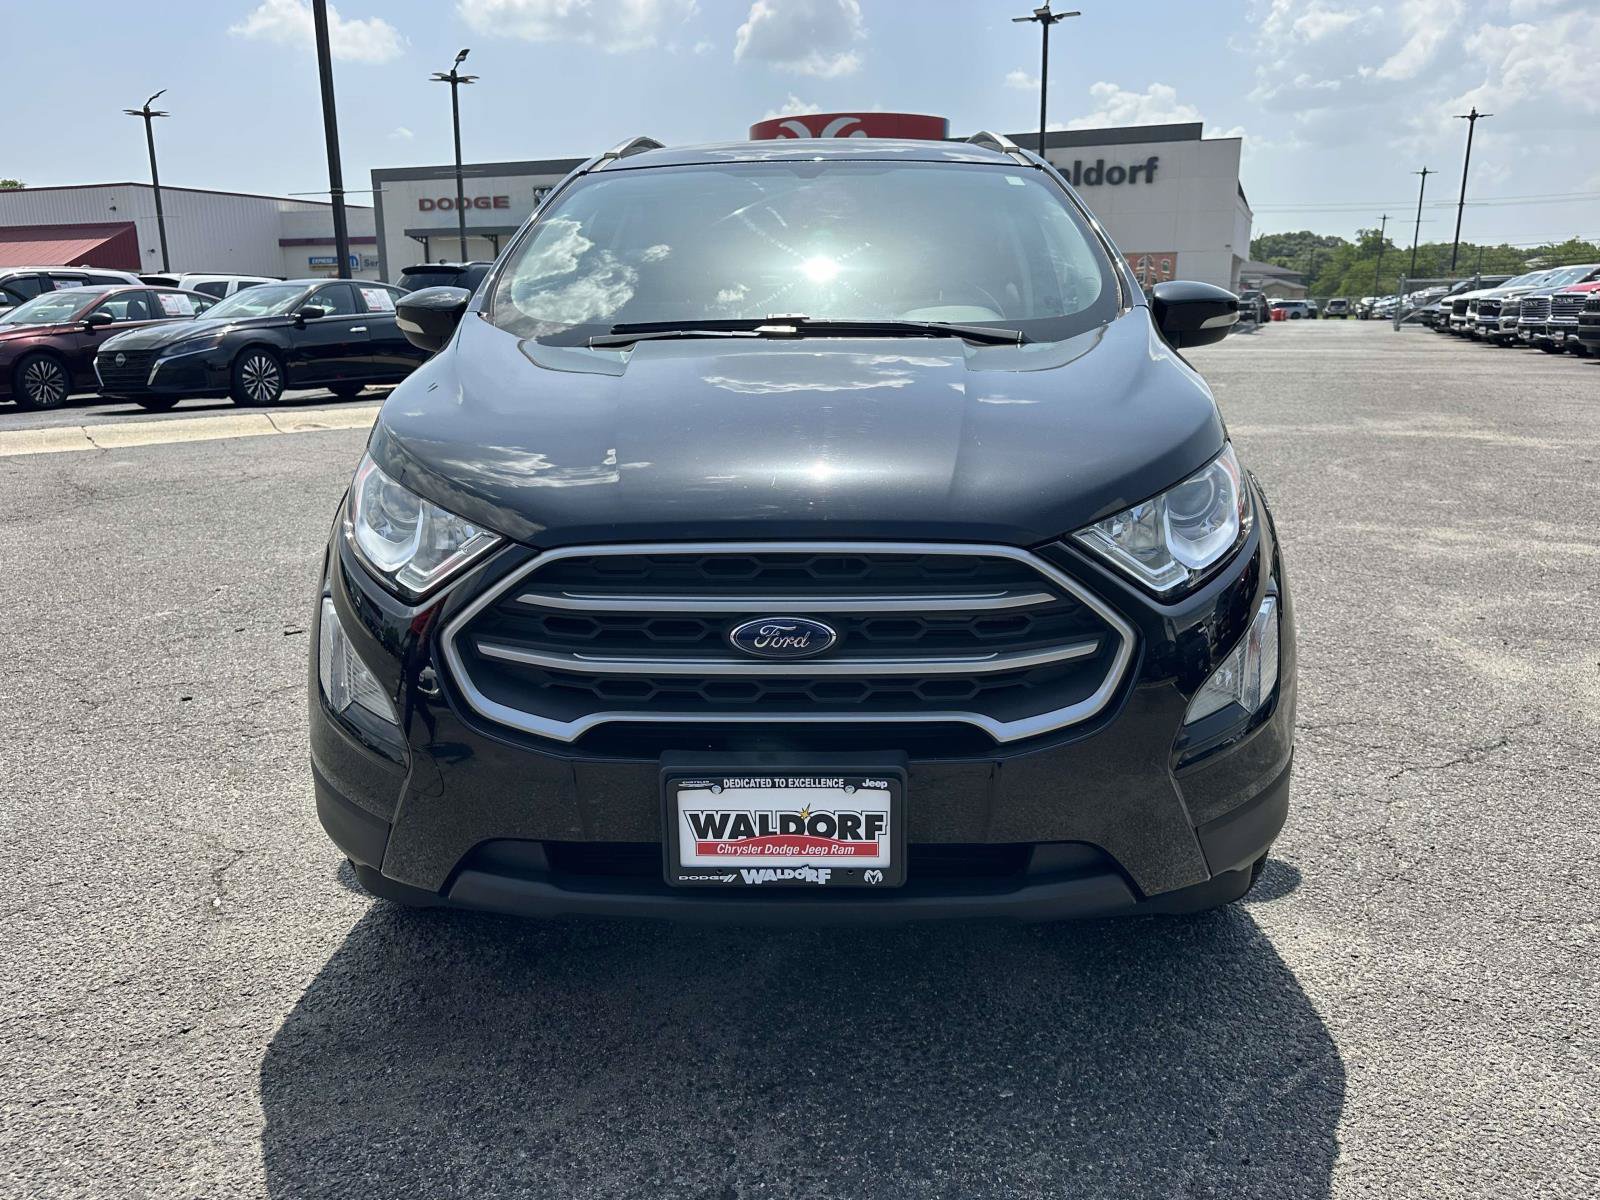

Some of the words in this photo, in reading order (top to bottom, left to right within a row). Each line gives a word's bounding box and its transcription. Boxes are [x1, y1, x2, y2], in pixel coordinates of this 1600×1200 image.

[1057, 156, 1159, 187] aldorf
[418, 195, 510, 211] DODGE
[754, 625, 810, 648] Ford
[723, 778, 772, 788] DEDICATED
[773, 778, 786, 788] TO
[788, 778, 844, 788] EXCELLENCE
[862, 779, 888, 789] Jeep
[684, 810, 887, 842] WALDORF
[716, 843, 763, 855] Chrysler
[764, 843, 799, 856] Dodge
[801, 843, 829, 856] Jeep
[830, 844, 855, 855] Ram
[740, 867, 832, 885] WALDORF
